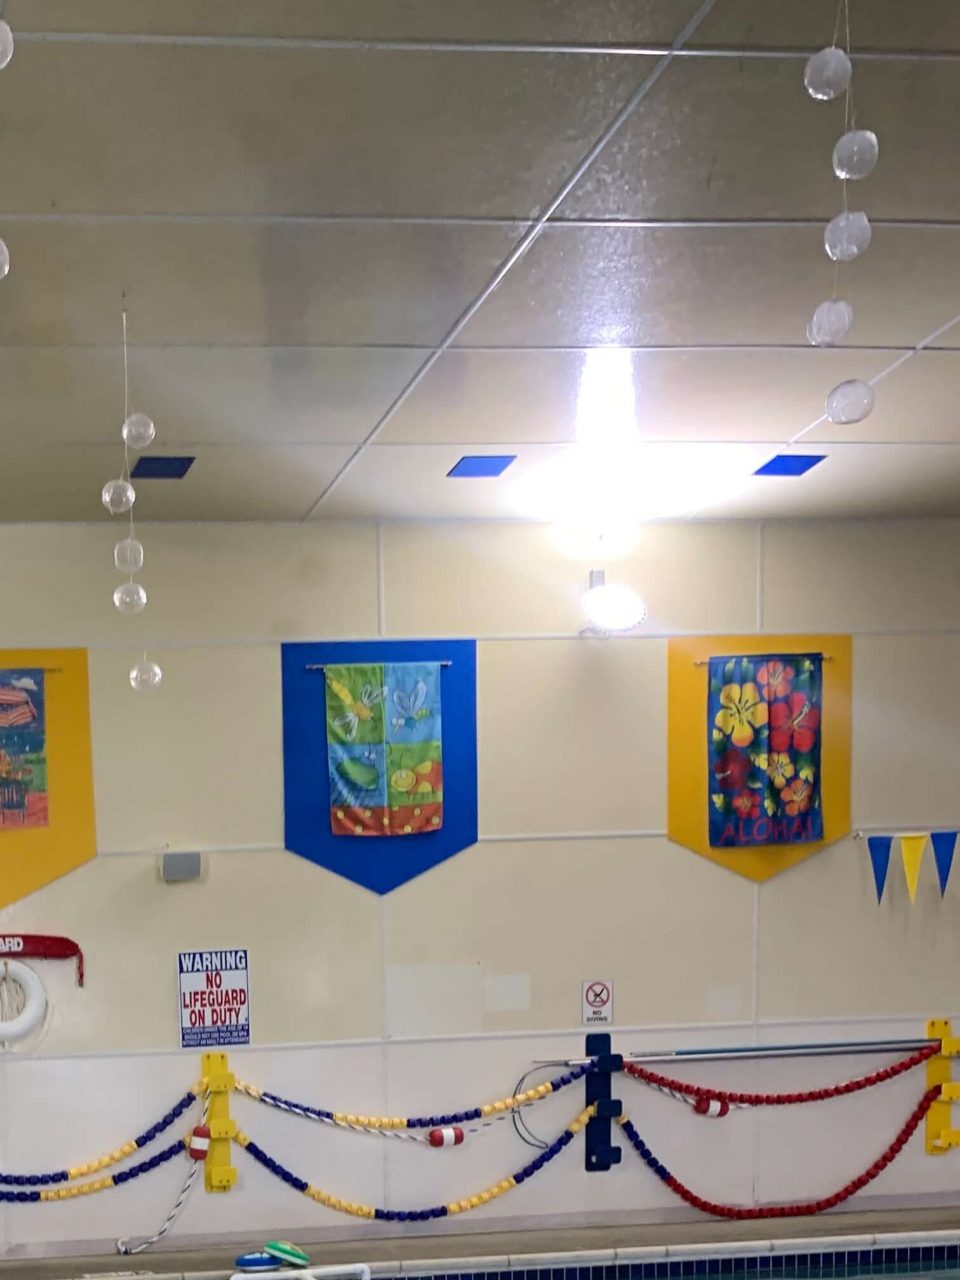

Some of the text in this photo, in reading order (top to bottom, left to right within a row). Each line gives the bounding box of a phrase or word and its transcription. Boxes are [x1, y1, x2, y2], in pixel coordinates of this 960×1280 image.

[181, 951, 246, 972] WARNING
[206, 972, 222, 989] NO
[183, 989, 246, 1008] LIFEGUARD
[190, 1007, 241, 1027] ON DUTY
